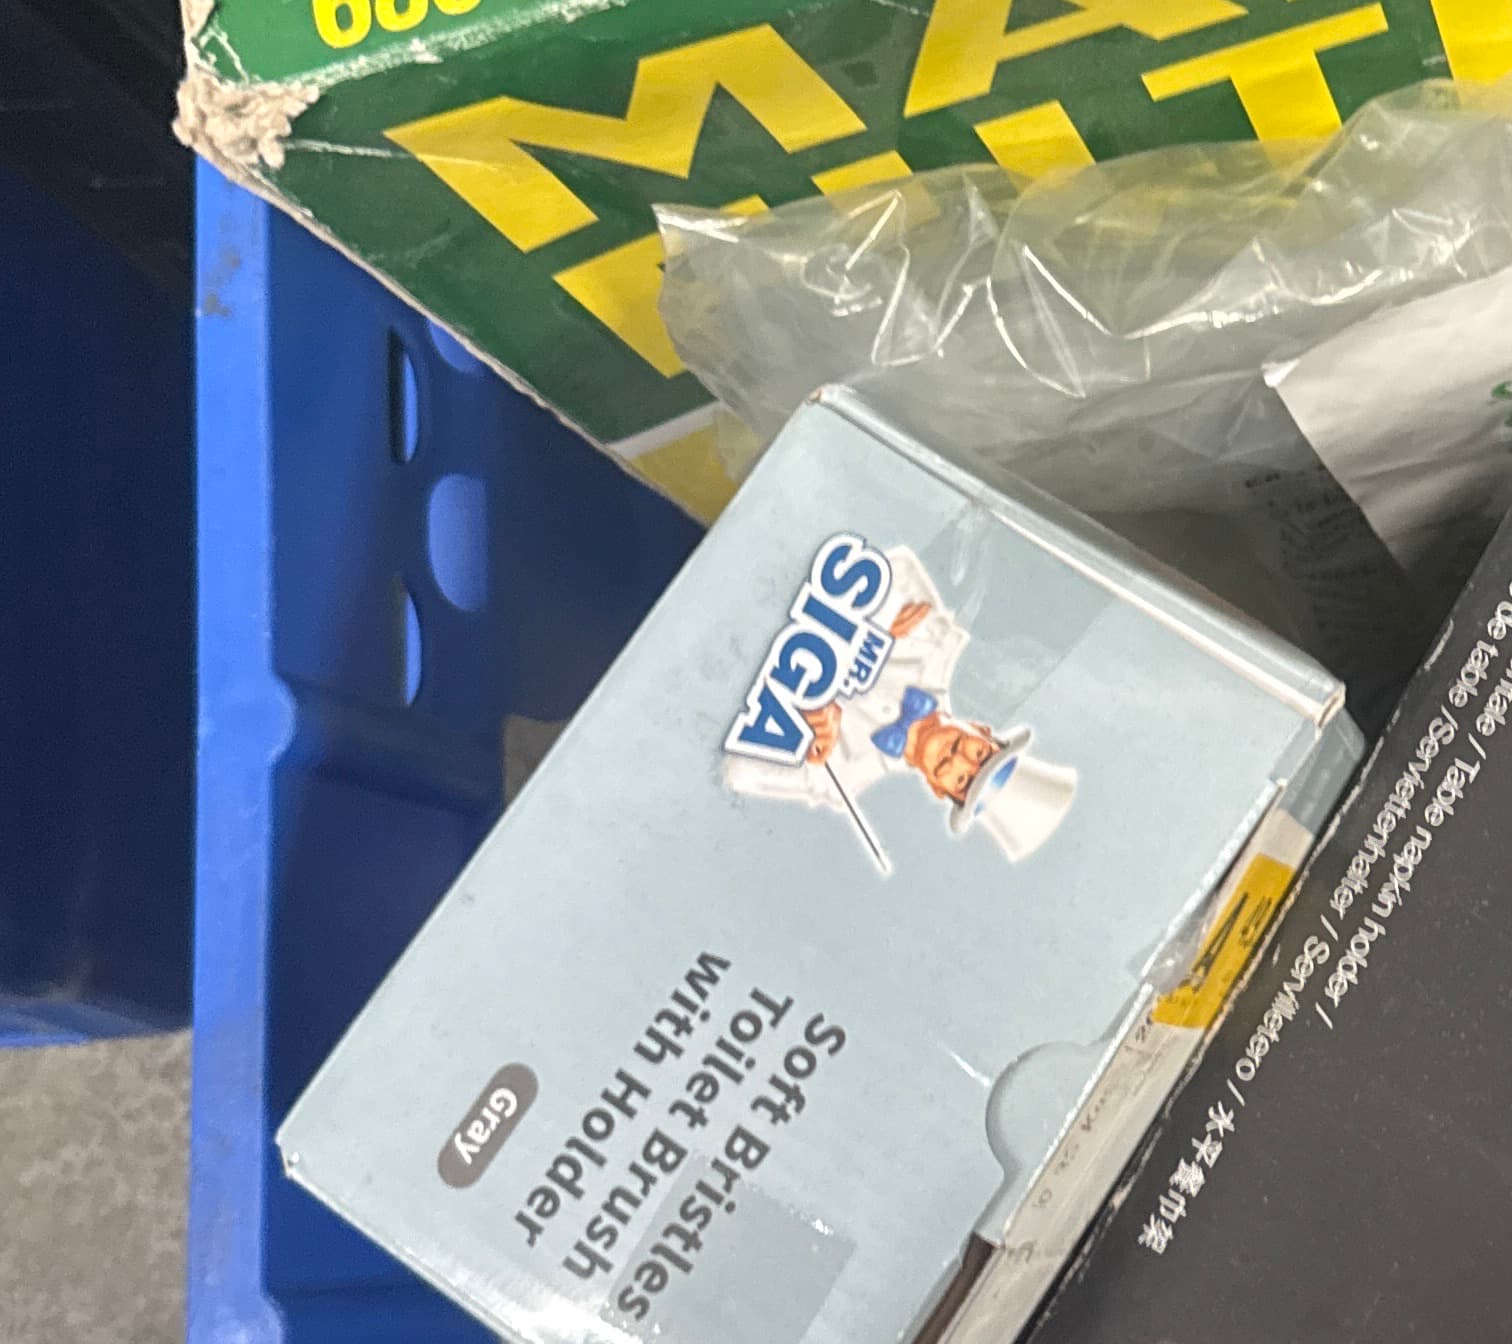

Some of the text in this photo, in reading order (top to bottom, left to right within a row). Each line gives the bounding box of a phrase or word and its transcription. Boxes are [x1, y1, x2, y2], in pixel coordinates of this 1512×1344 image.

[739, 545, 880, 752] SIGA
[842, 632, 884, 686] MR.
[1449, 640, 1498, 707] table
[1425, 758, 1480, 826] Table
[1372, 826, 1432, 917] napkin
[1236, 936, 1330, 1081] Servilletero
[1325, 917, 1385, 1008] holder
[454, 1088, 517, 1164] Gray
[515, 952, 731, 1247] with Holder
[563, 988, 794, 1279] Toilet Brush
[618, 1013, 846, 1321] Soft Bristles
[1139, 1101, 1234, 1254] 水平餐巾架
